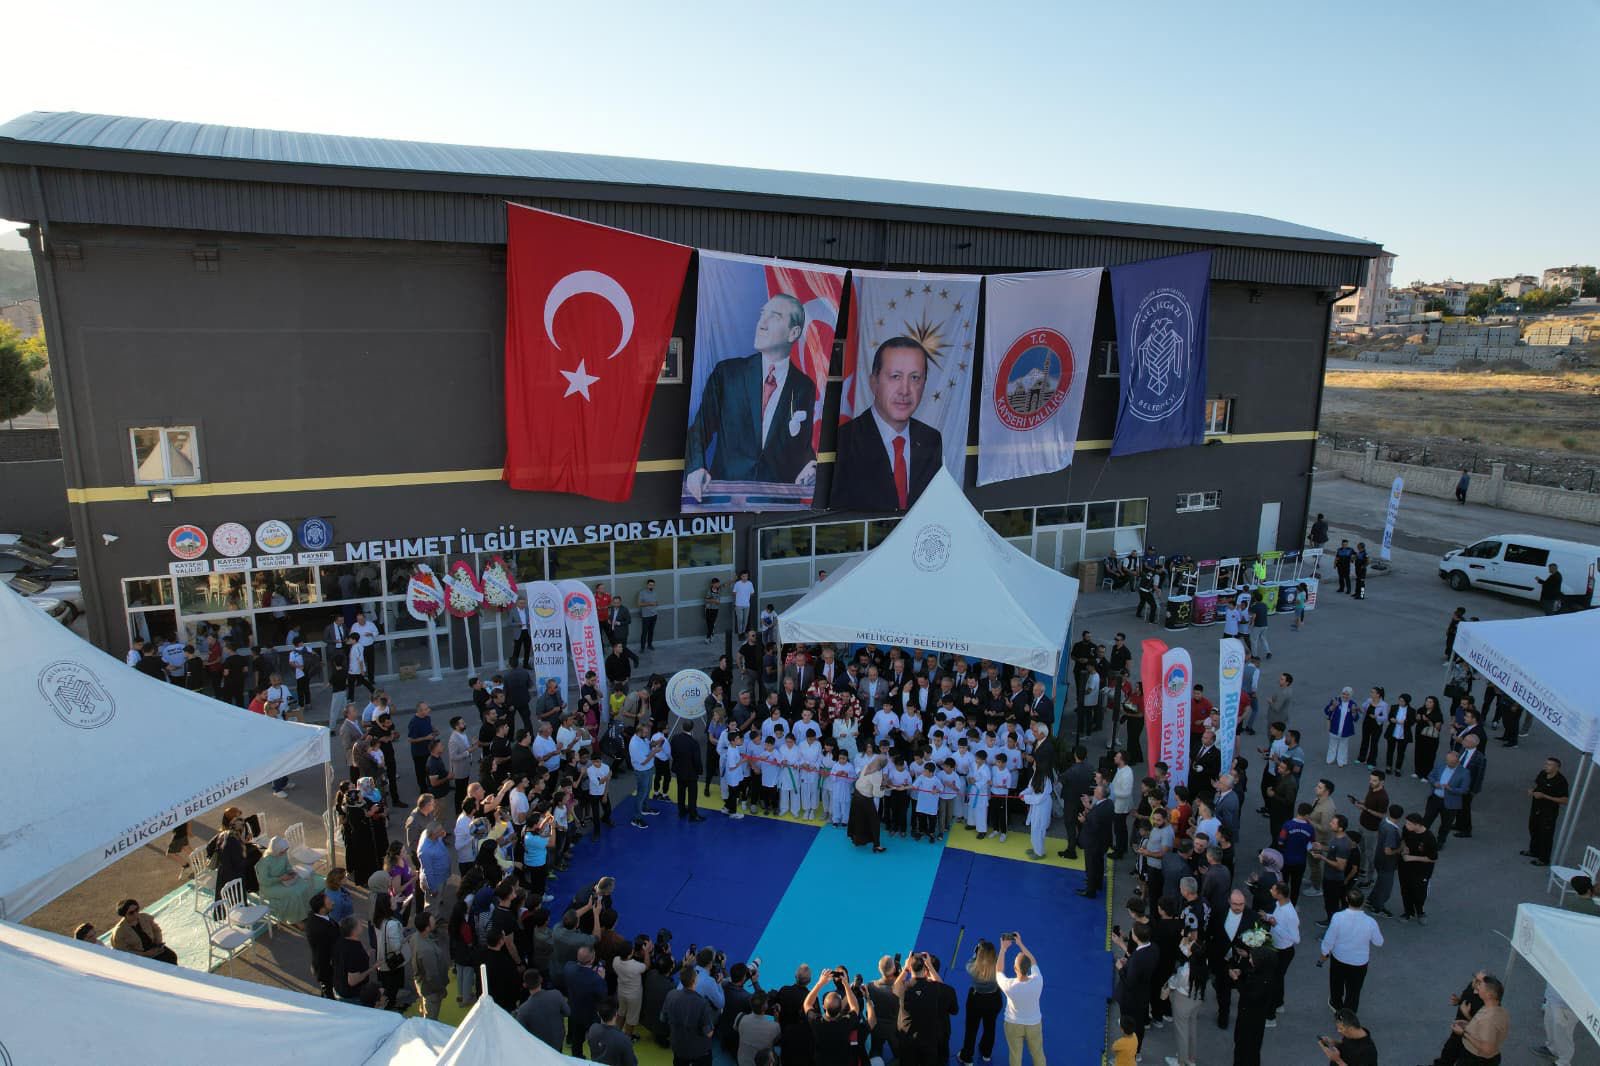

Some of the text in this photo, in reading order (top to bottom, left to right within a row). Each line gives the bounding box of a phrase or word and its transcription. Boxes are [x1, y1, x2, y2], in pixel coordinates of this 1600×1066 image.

[1030, 333, 1047, 344] T.C.
[997, 396, 1026, 427] KAYSERİ
[345, 515, 733, 562] MEHMET İLGÜ ERVA SPOR SALONU
[856, 630, 909, 645] MELİKGAZİ
[913, 638, 969, 652] BELEDİYESİ
[1469, 649, 1563, 727] MELİKGAZİ BELEDİYESİ
[103, 775, 249, 859] MELİKGAZİ BELEDİYESİ
